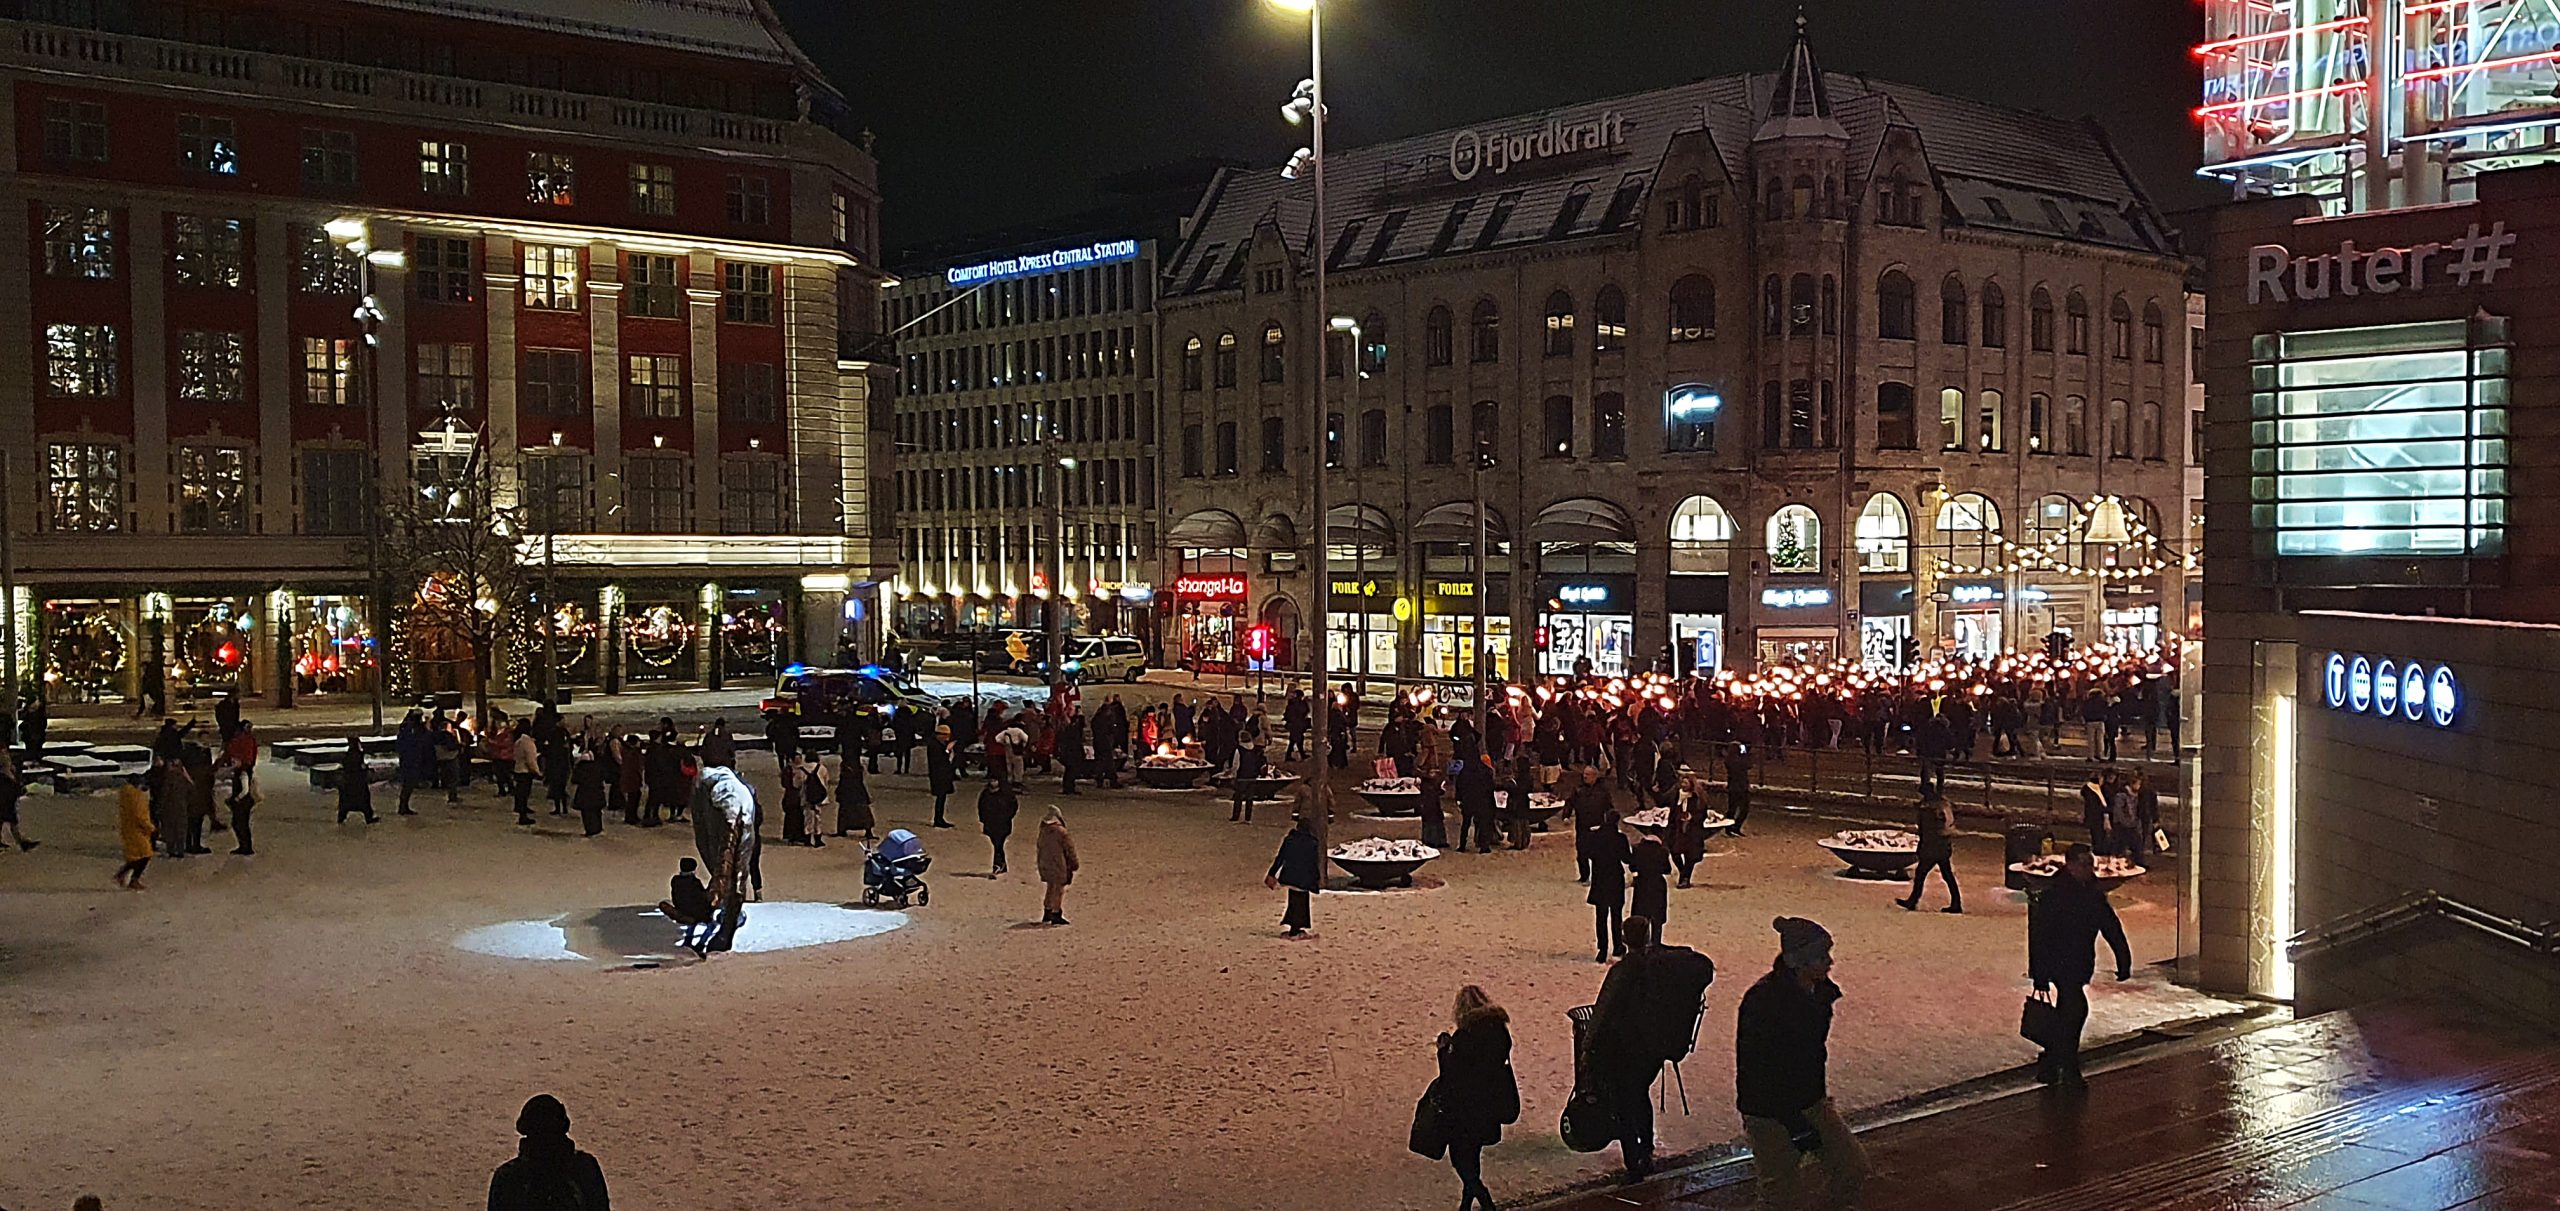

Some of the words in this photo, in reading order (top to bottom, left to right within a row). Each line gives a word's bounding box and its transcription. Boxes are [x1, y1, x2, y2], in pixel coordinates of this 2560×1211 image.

[1486, 109, 1624, 174] fjordkraft
[947, 264, 989, 283] COMFORT
[989, 259, 1019, 277] HOTEL
[1018, 253, 1051, 272] XPRESS
[1052, 249, 1093, 266] CENTRAL
[1093, 239, 1134, 260] STATION
[1438, 582, 1474, 596] FOREX
